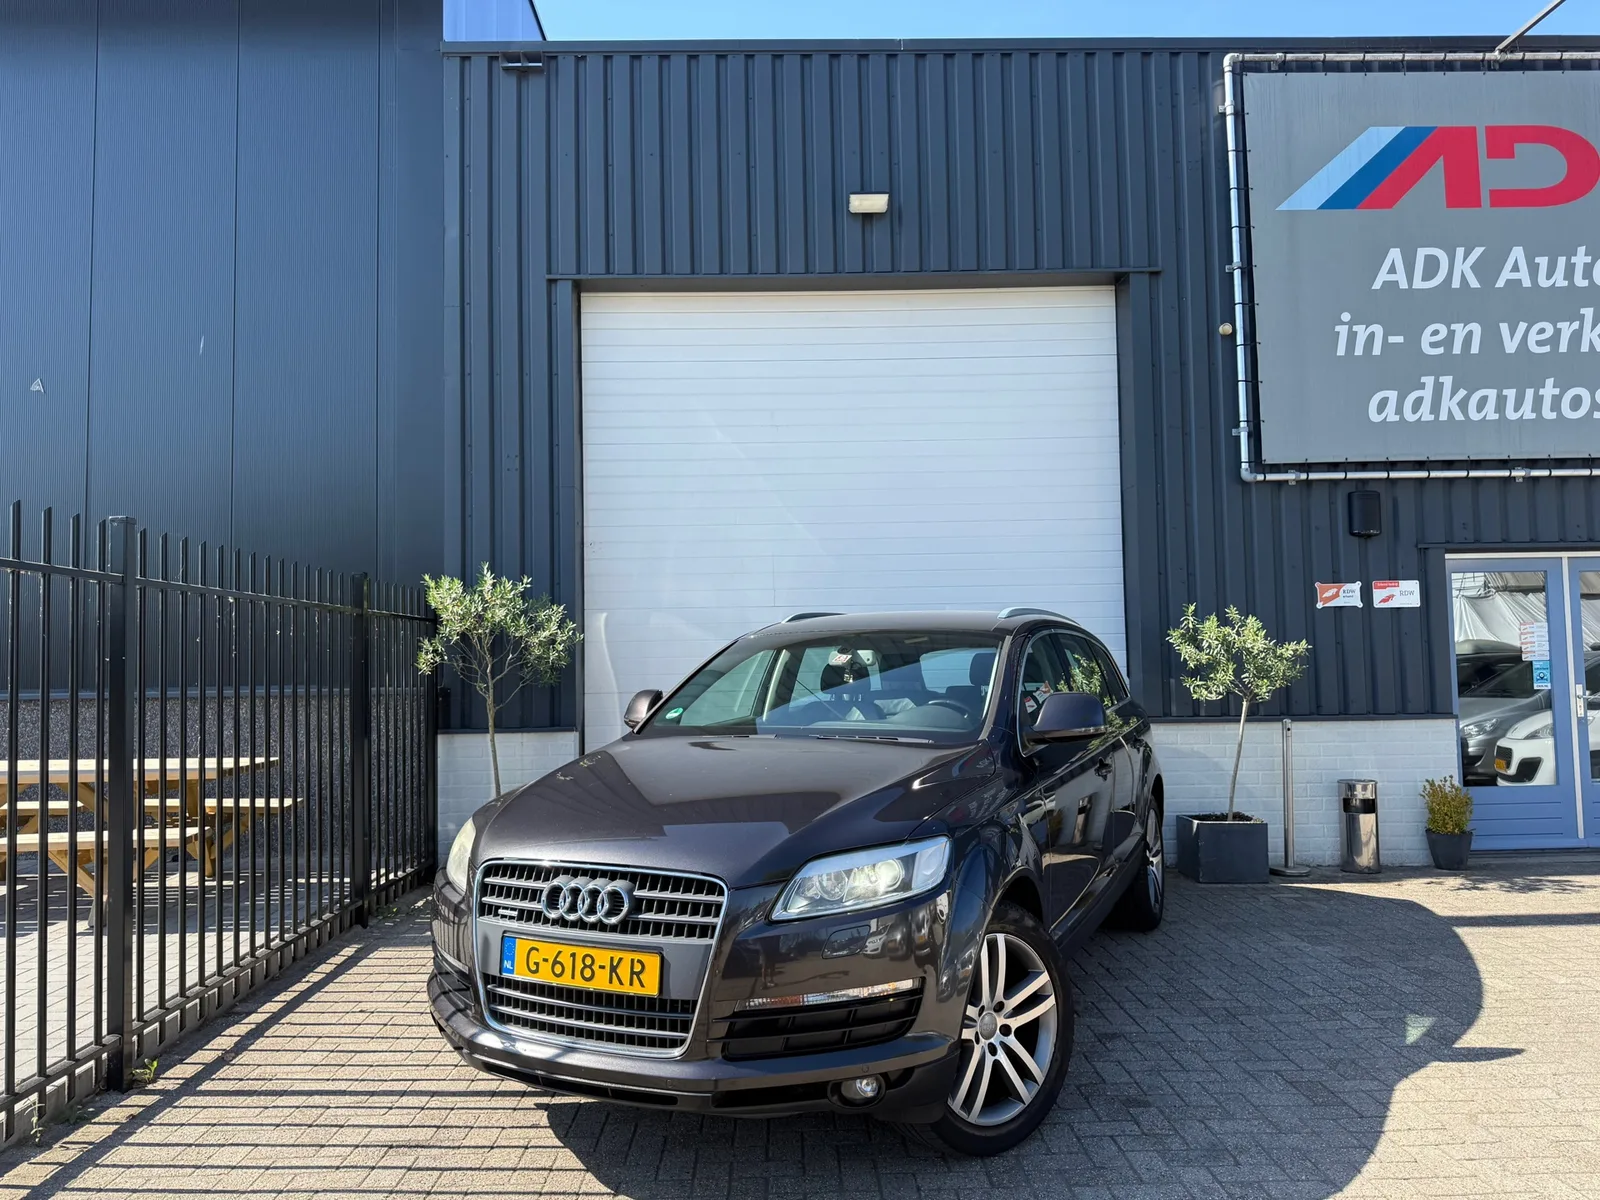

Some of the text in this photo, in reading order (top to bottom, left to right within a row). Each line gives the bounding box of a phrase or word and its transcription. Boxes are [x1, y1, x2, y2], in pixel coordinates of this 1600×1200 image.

[1371, 245, 1600, 290] ADK Aut
[1333, 312, 1405, 356] in-
[1420, 321, 1482, 355] en
[503, 946, 646, 989] NL G-618-KR
